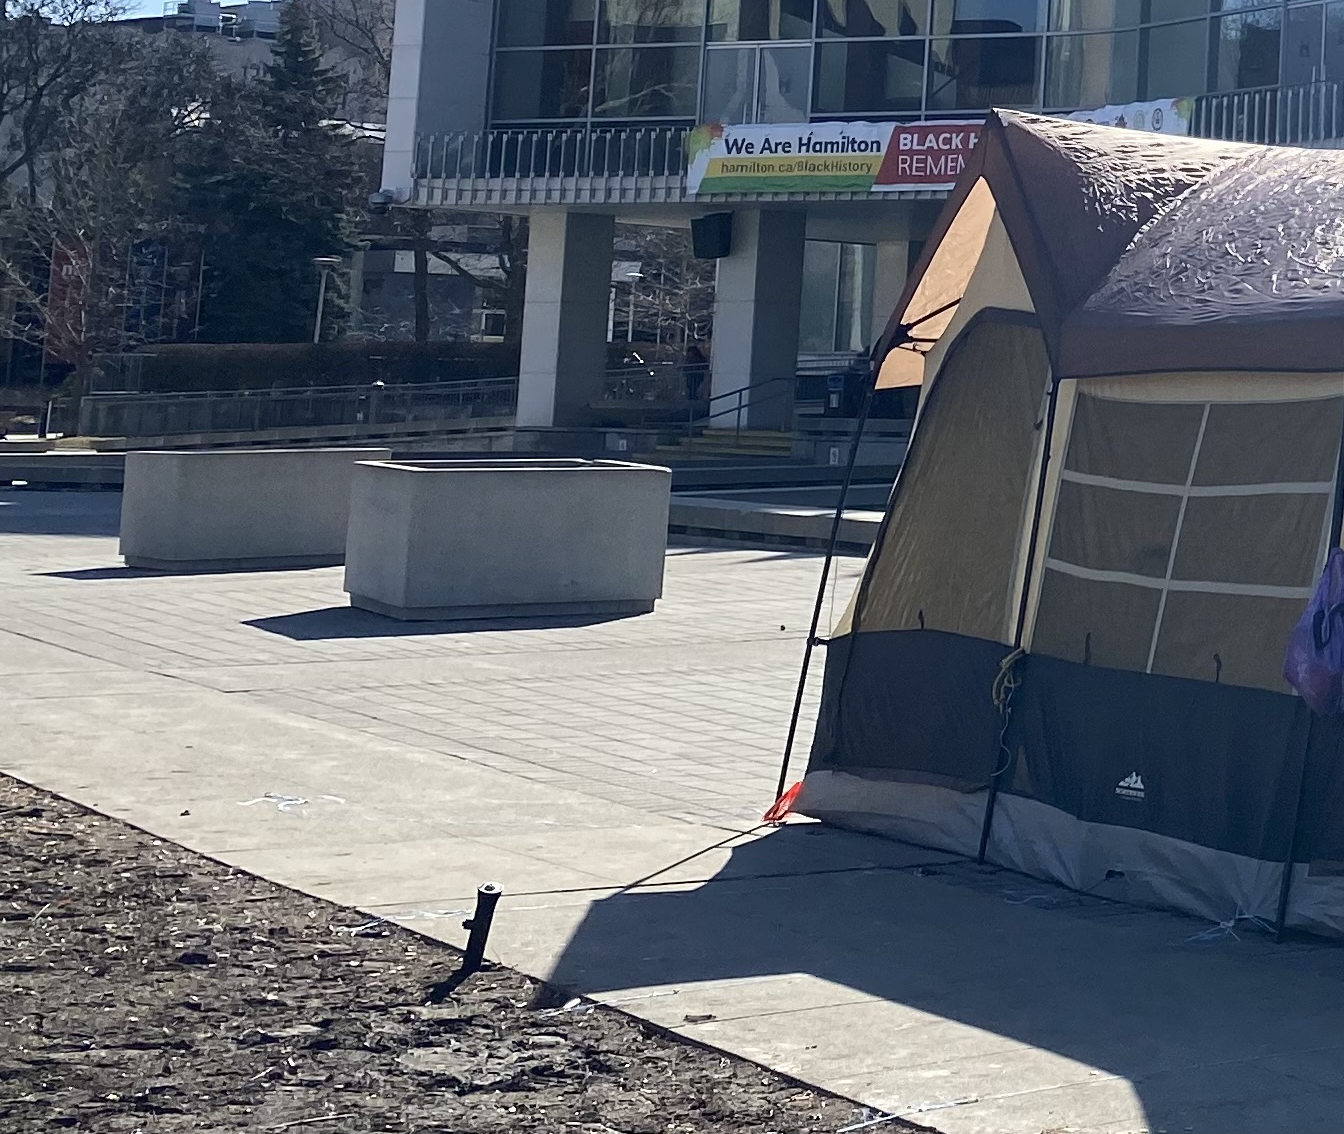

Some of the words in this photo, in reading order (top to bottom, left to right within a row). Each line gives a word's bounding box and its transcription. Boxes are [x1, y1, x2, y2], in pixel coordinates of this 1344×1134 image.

[724, 136, 755, 154] We
[759, 134, 792, 154] Are
[799, 133, 881, 154] Hamilton
[900, 132, 964, 150] BLACK
